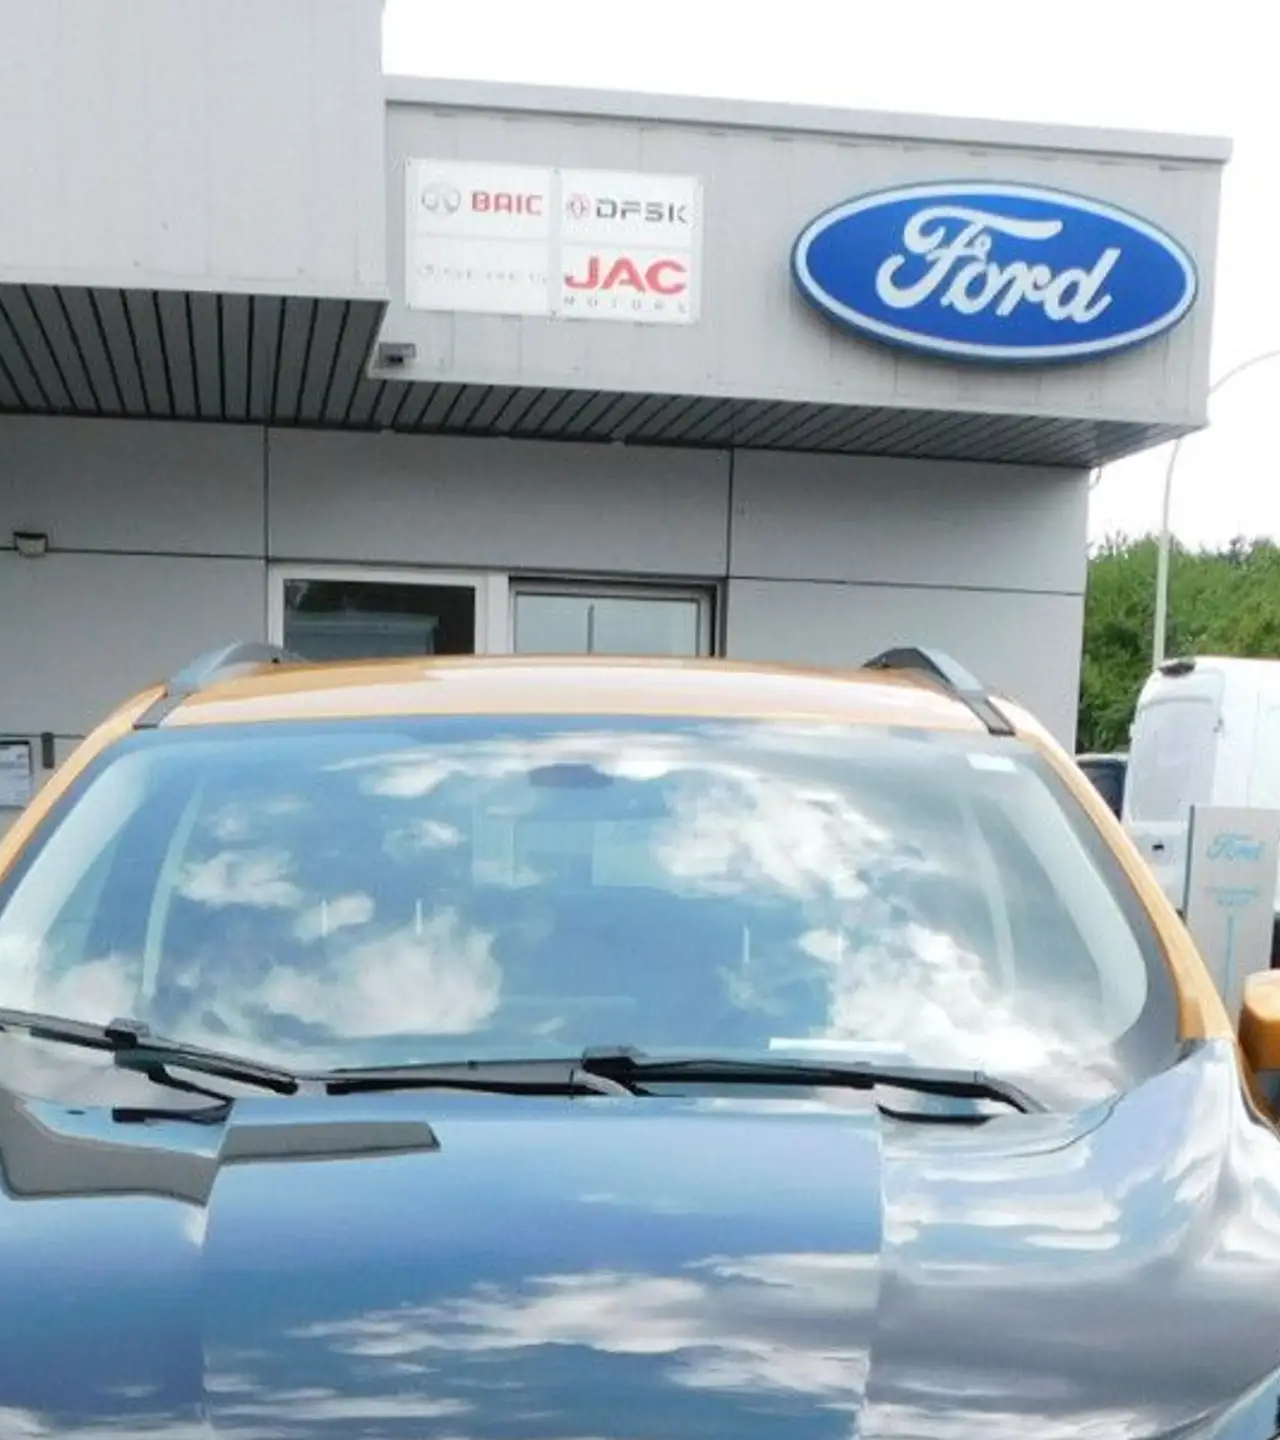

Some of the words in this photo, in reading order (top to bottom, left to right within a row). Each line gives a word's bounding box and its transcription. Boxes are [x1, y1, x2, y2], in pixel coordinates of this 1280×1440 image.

[471, 190, 543, 216] BAIC
[595, 197, 689, 225] DFSK
[563, 255, 688, 295] JAC
[875, 204, 1122, 324] Ford
